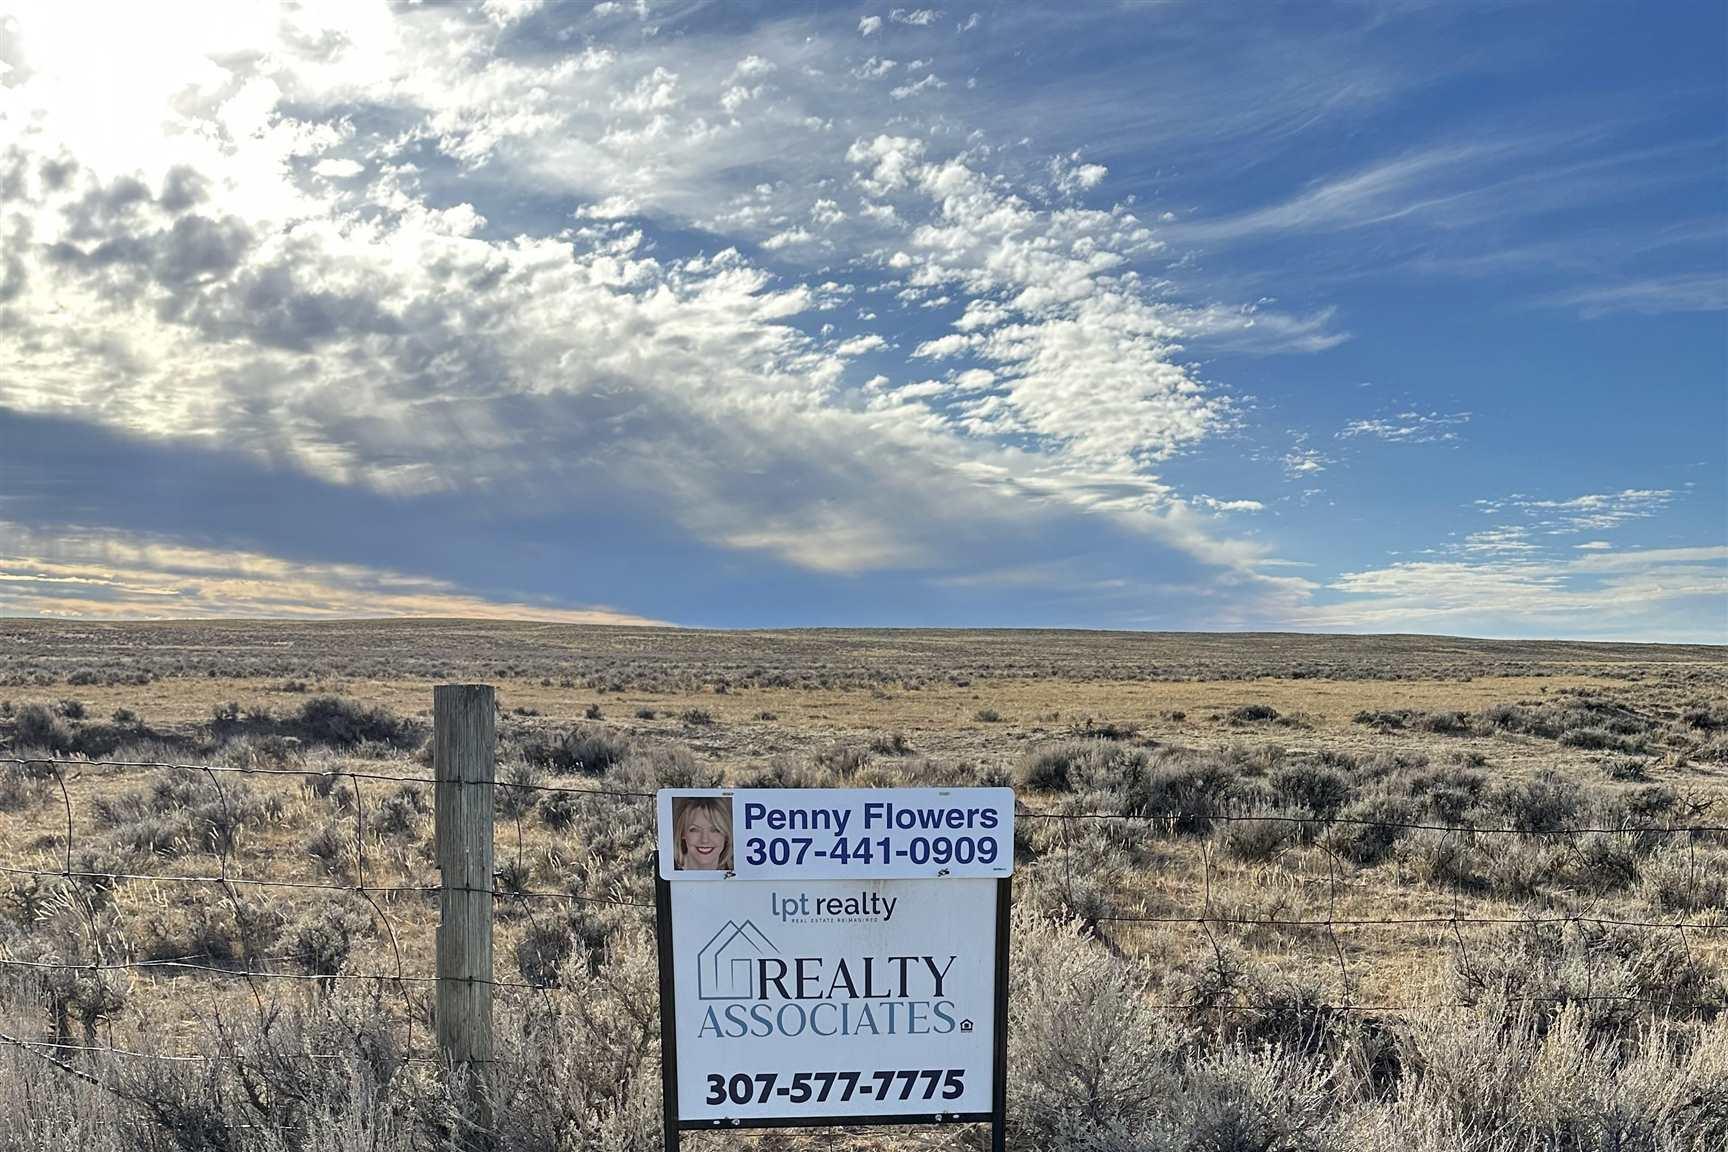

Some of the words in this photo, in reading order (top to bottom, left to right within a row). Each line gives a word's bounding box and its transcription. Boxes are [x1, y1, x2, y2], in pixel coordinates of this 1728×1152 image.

[744, 803, 851, 836] Penny
[864, 802, 998, 830] Flowers
[746, 836, 998, 866] 307-441-0909
[771, 892, 810, 922] lpt
[816, 892, 897, 921] realty
[758, 955, 957, 1000] REALTY
[697, 1000, 956, 1039] ASSOCIATES
[705, 1069, 966, 1106] 307-577-7775
